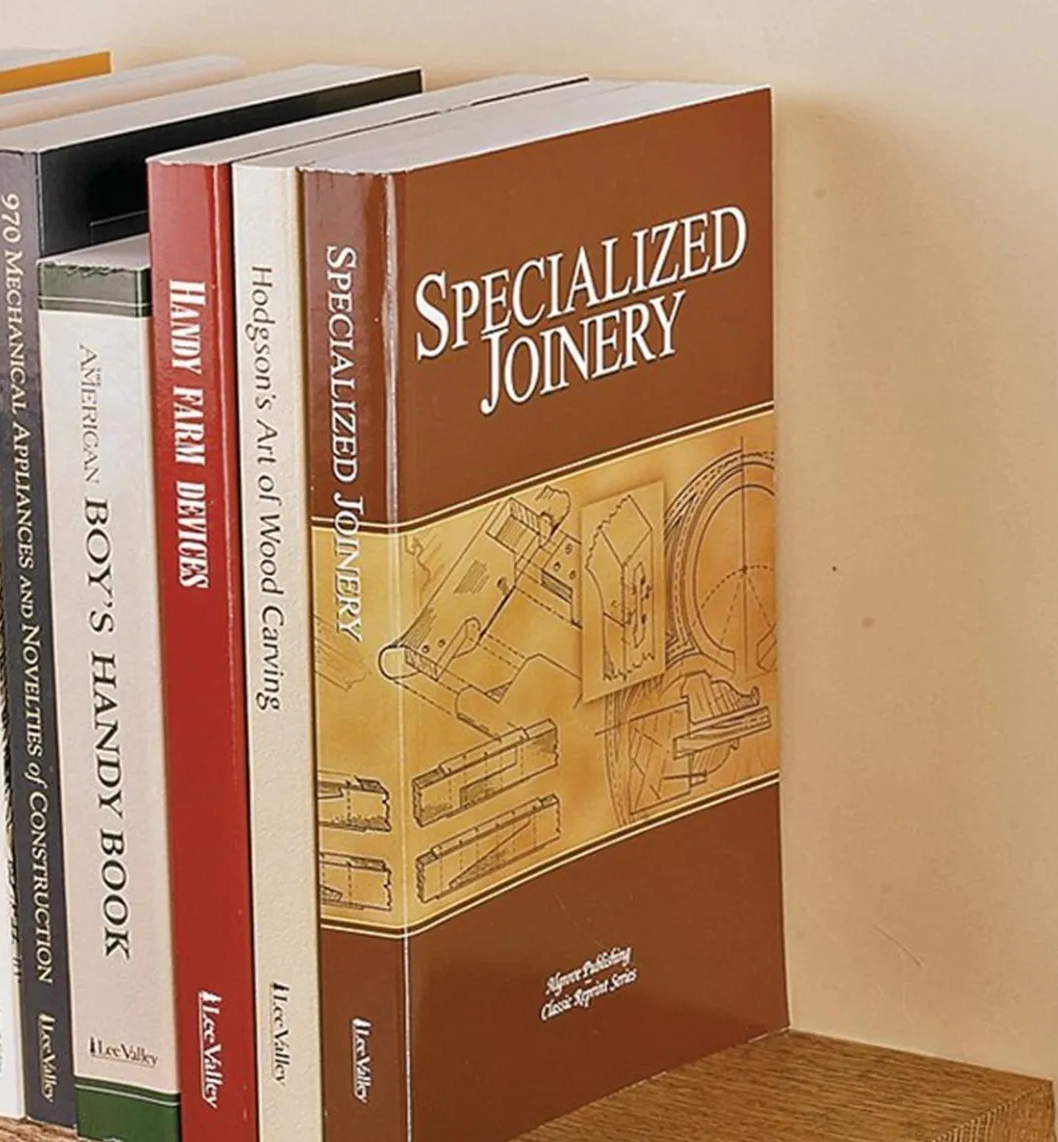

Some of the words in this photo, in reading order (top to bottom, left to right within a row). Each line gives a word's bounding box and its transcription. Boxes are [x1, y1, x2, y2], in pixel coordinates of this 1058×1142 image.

[1, 193, 22, 244] 970
[415, 205, 749, 361] SPECIALIZED
[4, 250, 29, 414] MECHANICAL
[169, 279, 206, 375] HANDY
[245, 266, 277, 411] Hodgson's
[326, 245, 358, 484] SPECIALIZED
[479, 290, 687, 416] JOINERY
[79, 343, 101, 484] AMERICAN
[173, 385, 206, 466] FARM
[255, 418, 278, 465] Art
[12, 422, 35, 570] APPLIANCES
[176, 480, 209, 589] DEVICES
[257, 473, 283, 509] of
[259, 511, 286, 596] Wood
[83, 497, 115, 634] BOY'S
[332, 492, 364, 642] JOINERY
[22, 624, 43, 757] NOVELTIES
[256, 605, 285, 711] Carving
[24, 762, 48, 792] of
[91, 650, 124, 819] HANDY
[28, 790, 53, 983] CONSTRUCTION
[99, 827, 130, 960] BOOK
